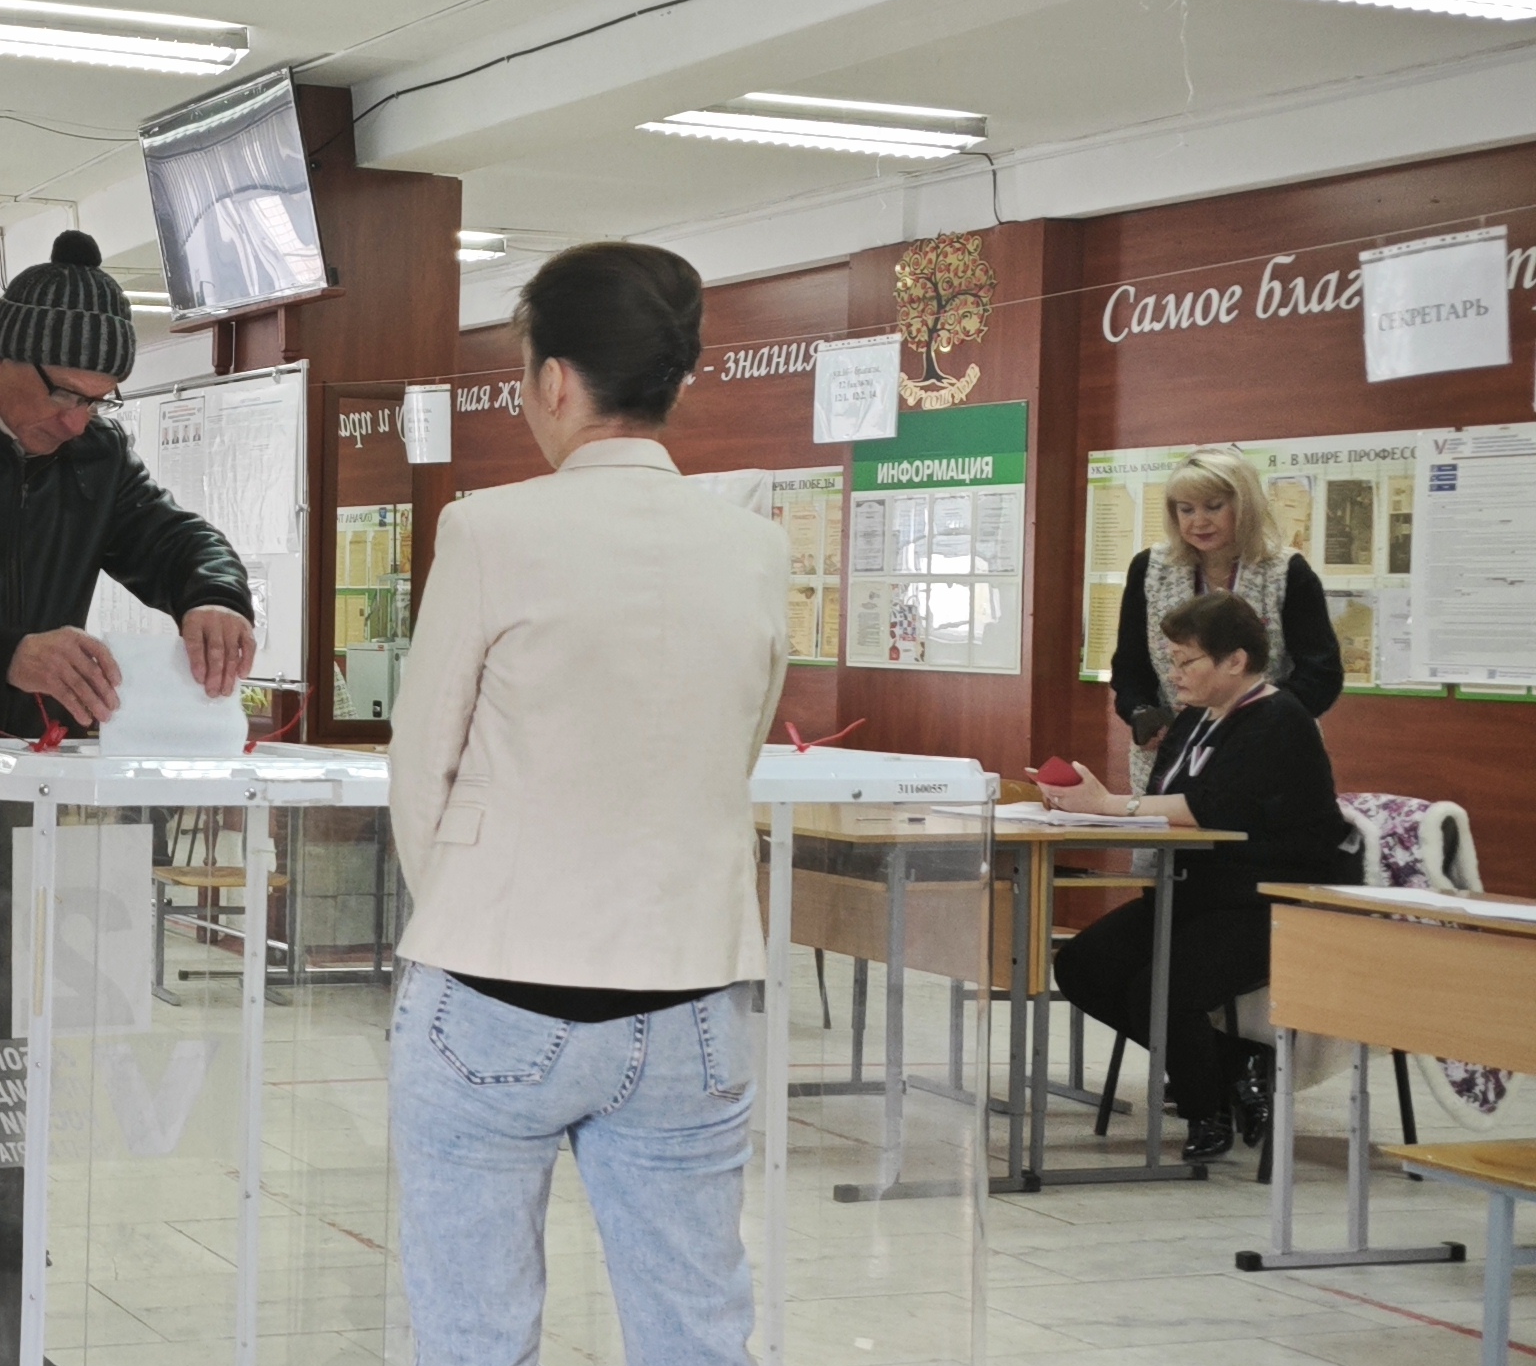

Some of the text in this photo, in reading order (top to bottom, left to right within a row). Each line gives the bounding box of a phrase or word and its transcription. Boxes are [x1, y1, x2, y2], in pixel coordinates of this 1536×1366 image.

[1102, 284, 1242, 343] Самое
[1378, 297, 1490, 332] СЕКРЕТАРЬ
[456, 385, 491, 413] ная
[877, 456, 993, 484] ИНФОРМАЦИЯ
[1290, 453, 1299, 466] В
[1303, 450, 1343, 465] МИРЕ
